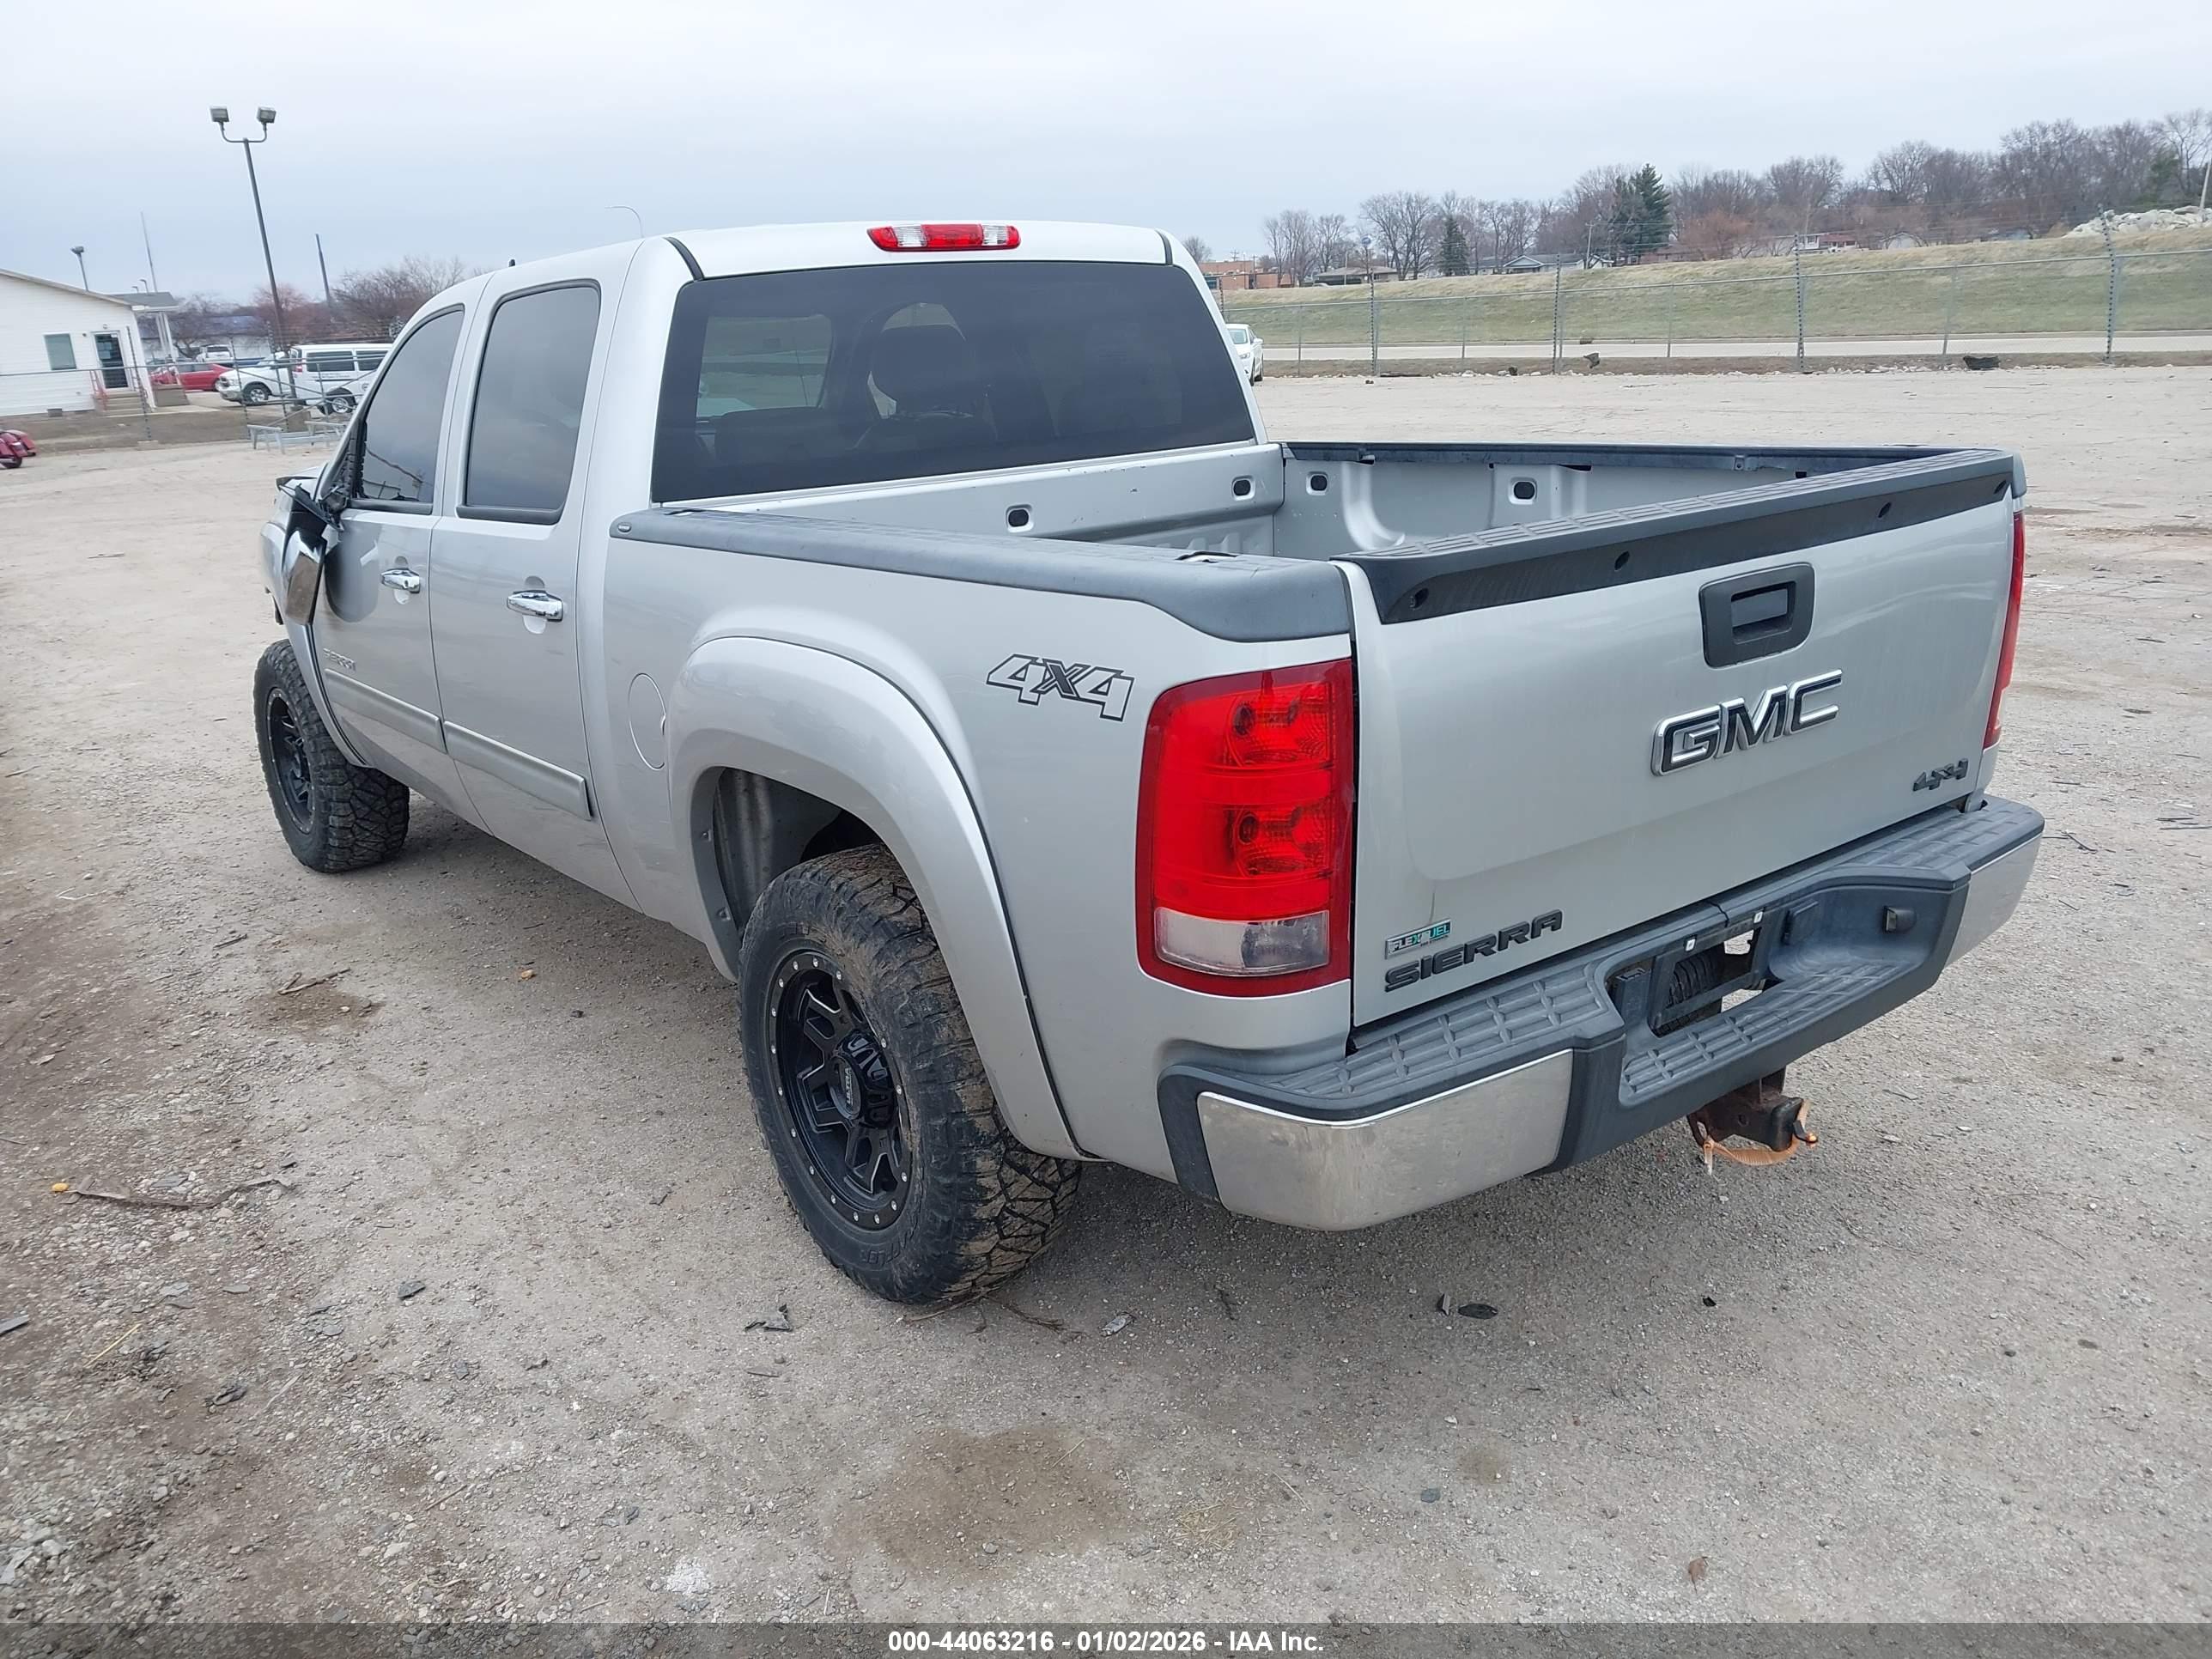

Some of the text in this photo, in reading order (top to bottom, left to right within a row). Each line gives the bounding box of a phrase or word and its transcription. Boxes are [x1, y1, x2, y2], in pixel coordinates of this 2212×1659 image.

[986, 653, 1134, 722] 4X4
[1650, 669, 1843, 776] GMC
[1384, 908, 1564, 993] SIERRA
